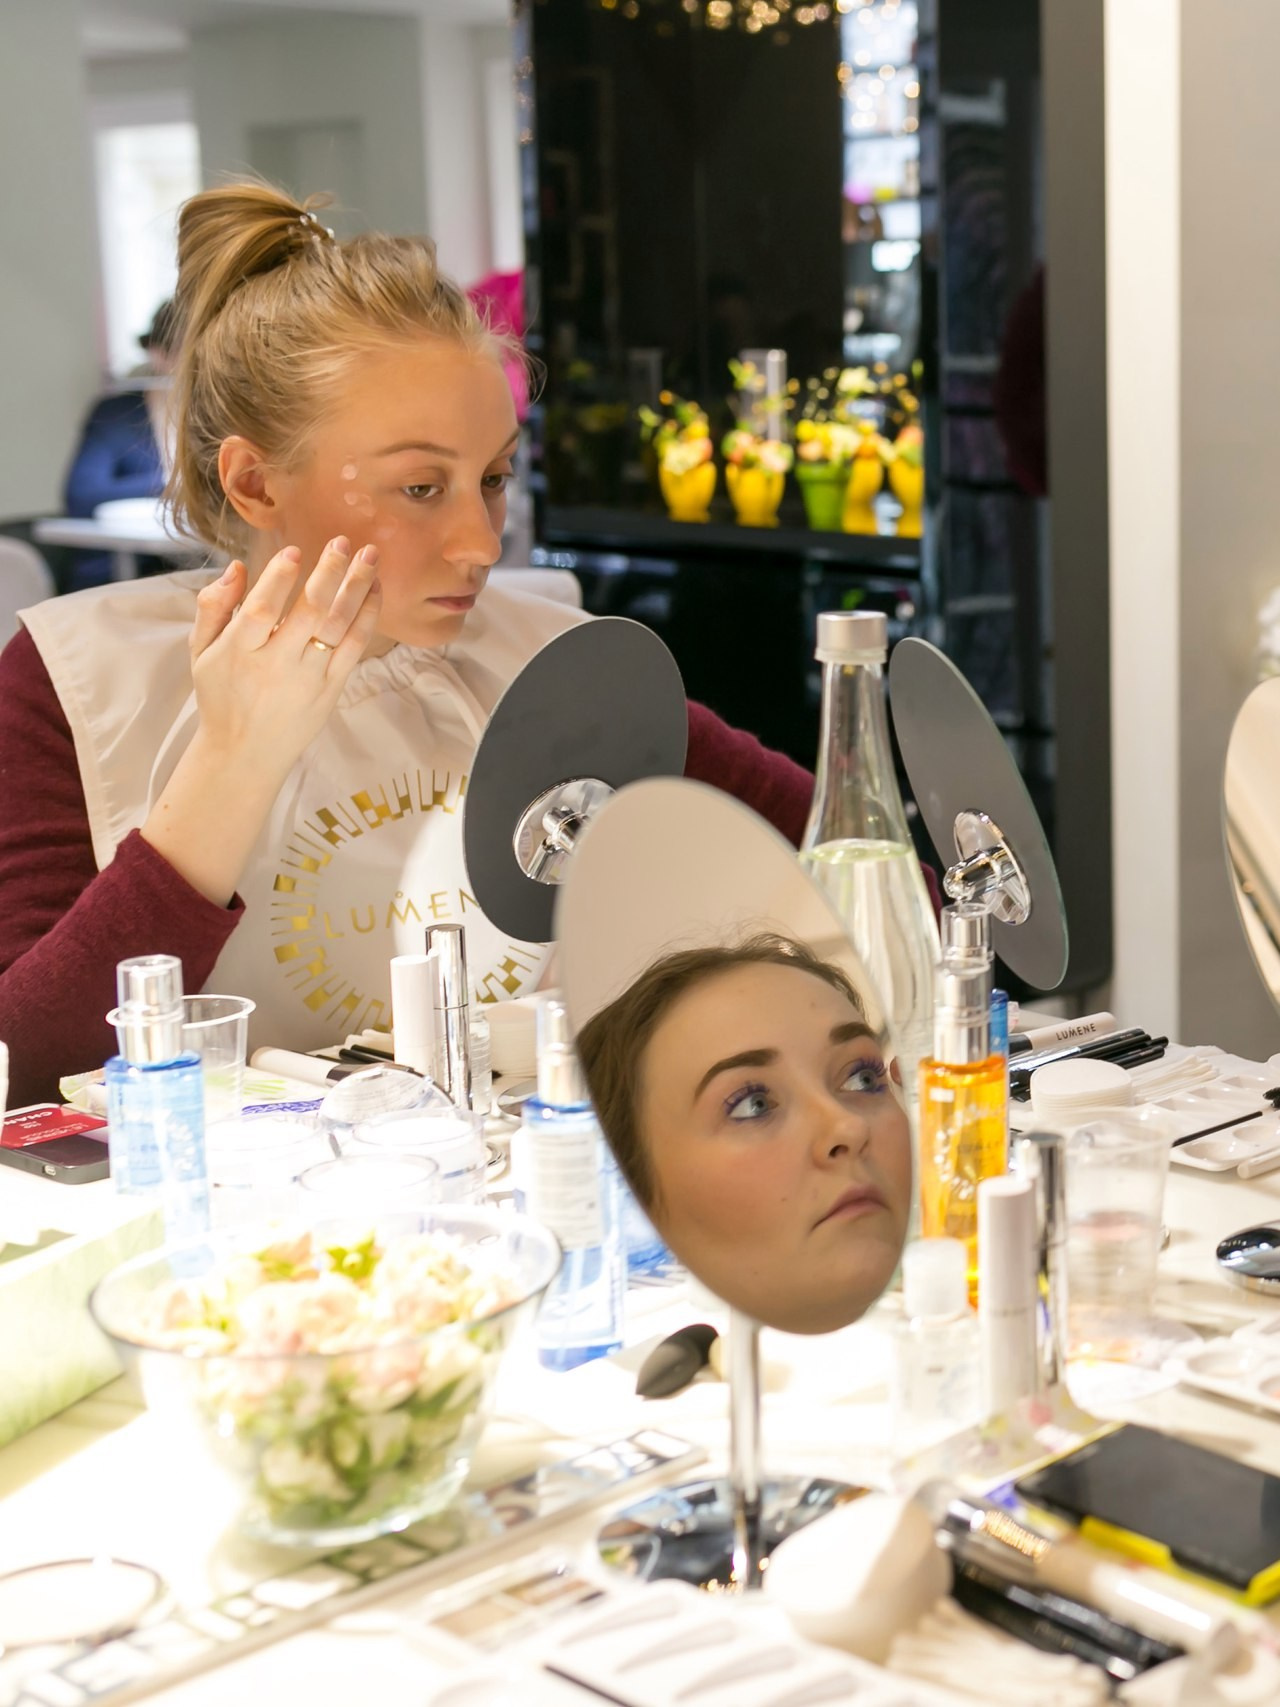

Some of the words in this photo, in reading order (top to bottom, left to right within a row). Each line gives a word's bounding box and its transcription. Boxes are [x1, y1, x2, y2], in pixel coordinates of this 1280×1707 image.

[323, 888, 481, 939] LUMEN
[1055, 1023, 1097, 1041] LUMENE
[3, 1111, 53, 1126] CHAN
